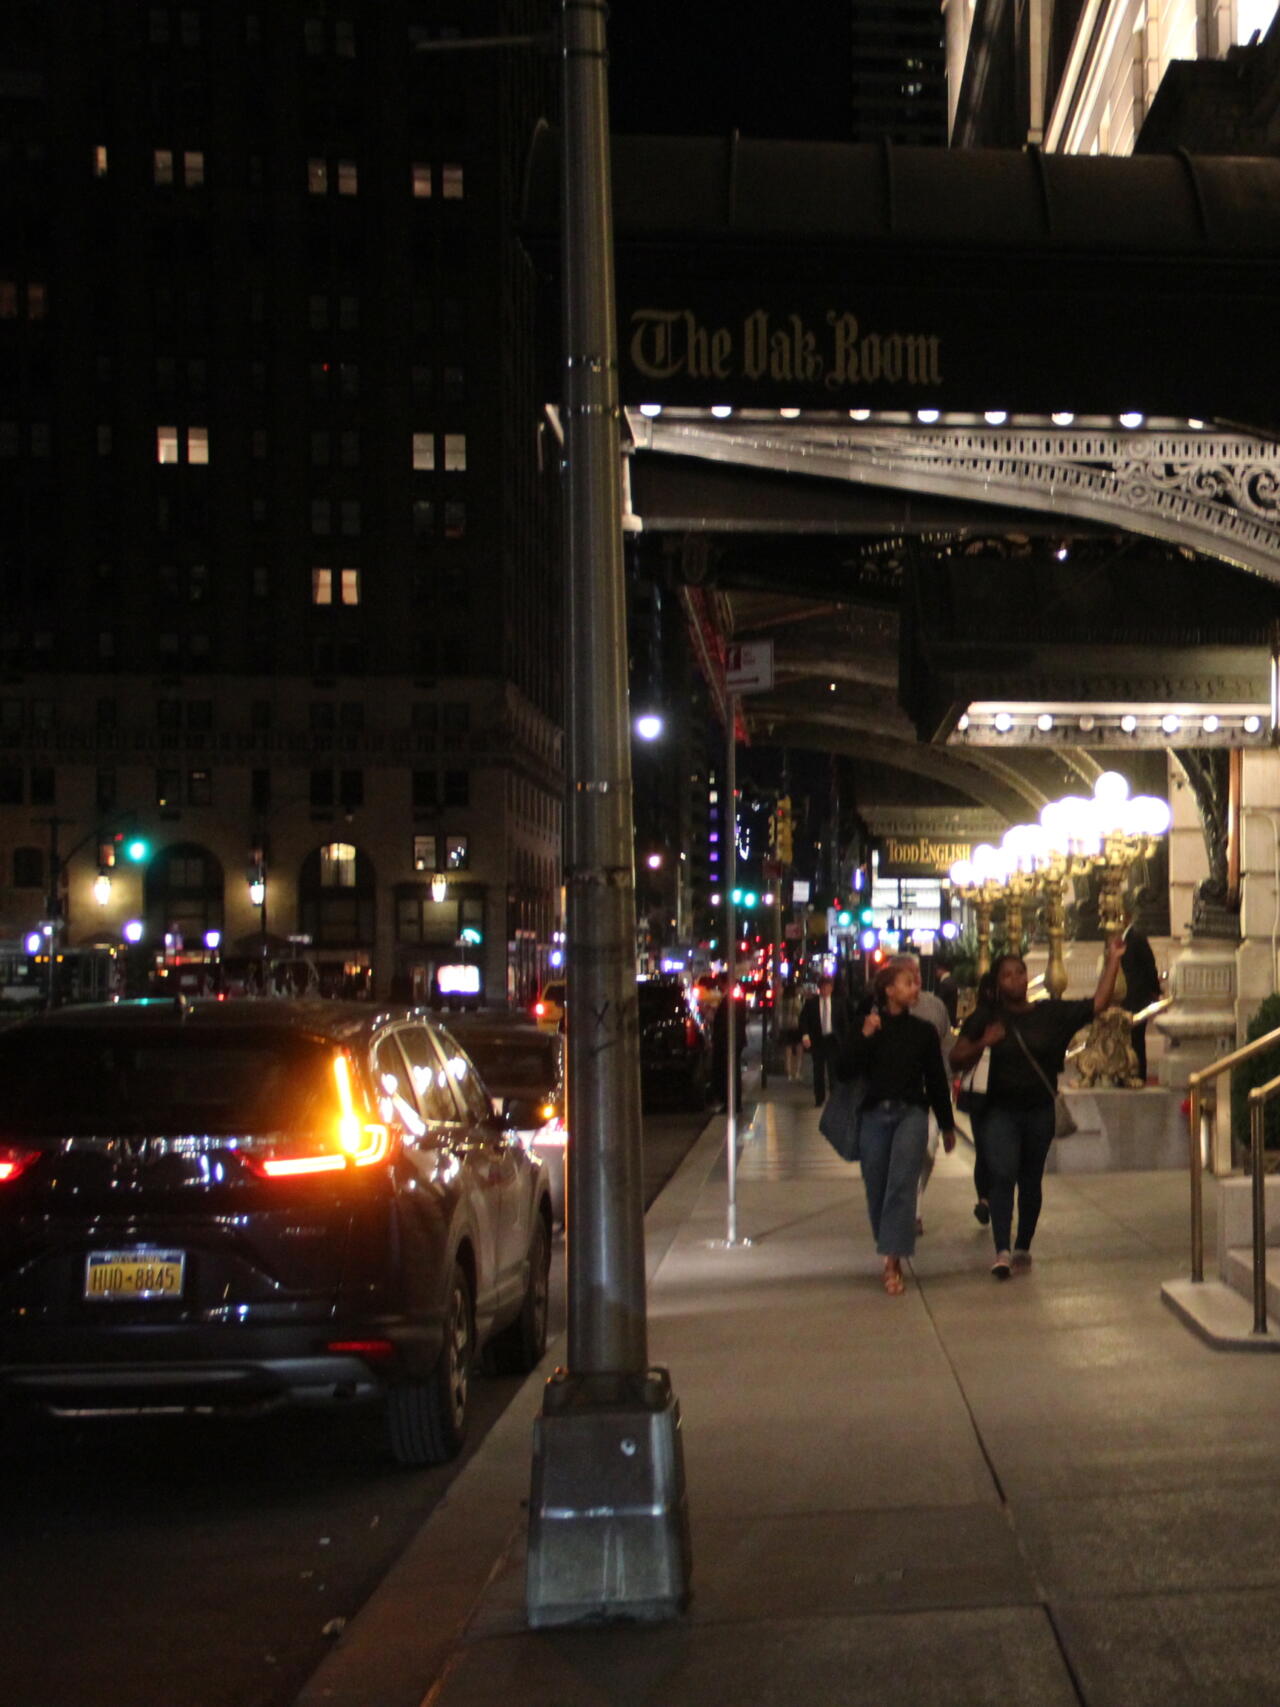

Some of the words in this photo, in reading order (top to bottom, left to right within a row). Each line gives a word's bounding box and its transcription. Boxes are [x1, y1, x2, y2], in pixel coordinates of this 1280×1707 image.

[629, 308, 732, 380] The
[743, 308, 824, 382] Oak
[824, 308, 944, 392] Room
